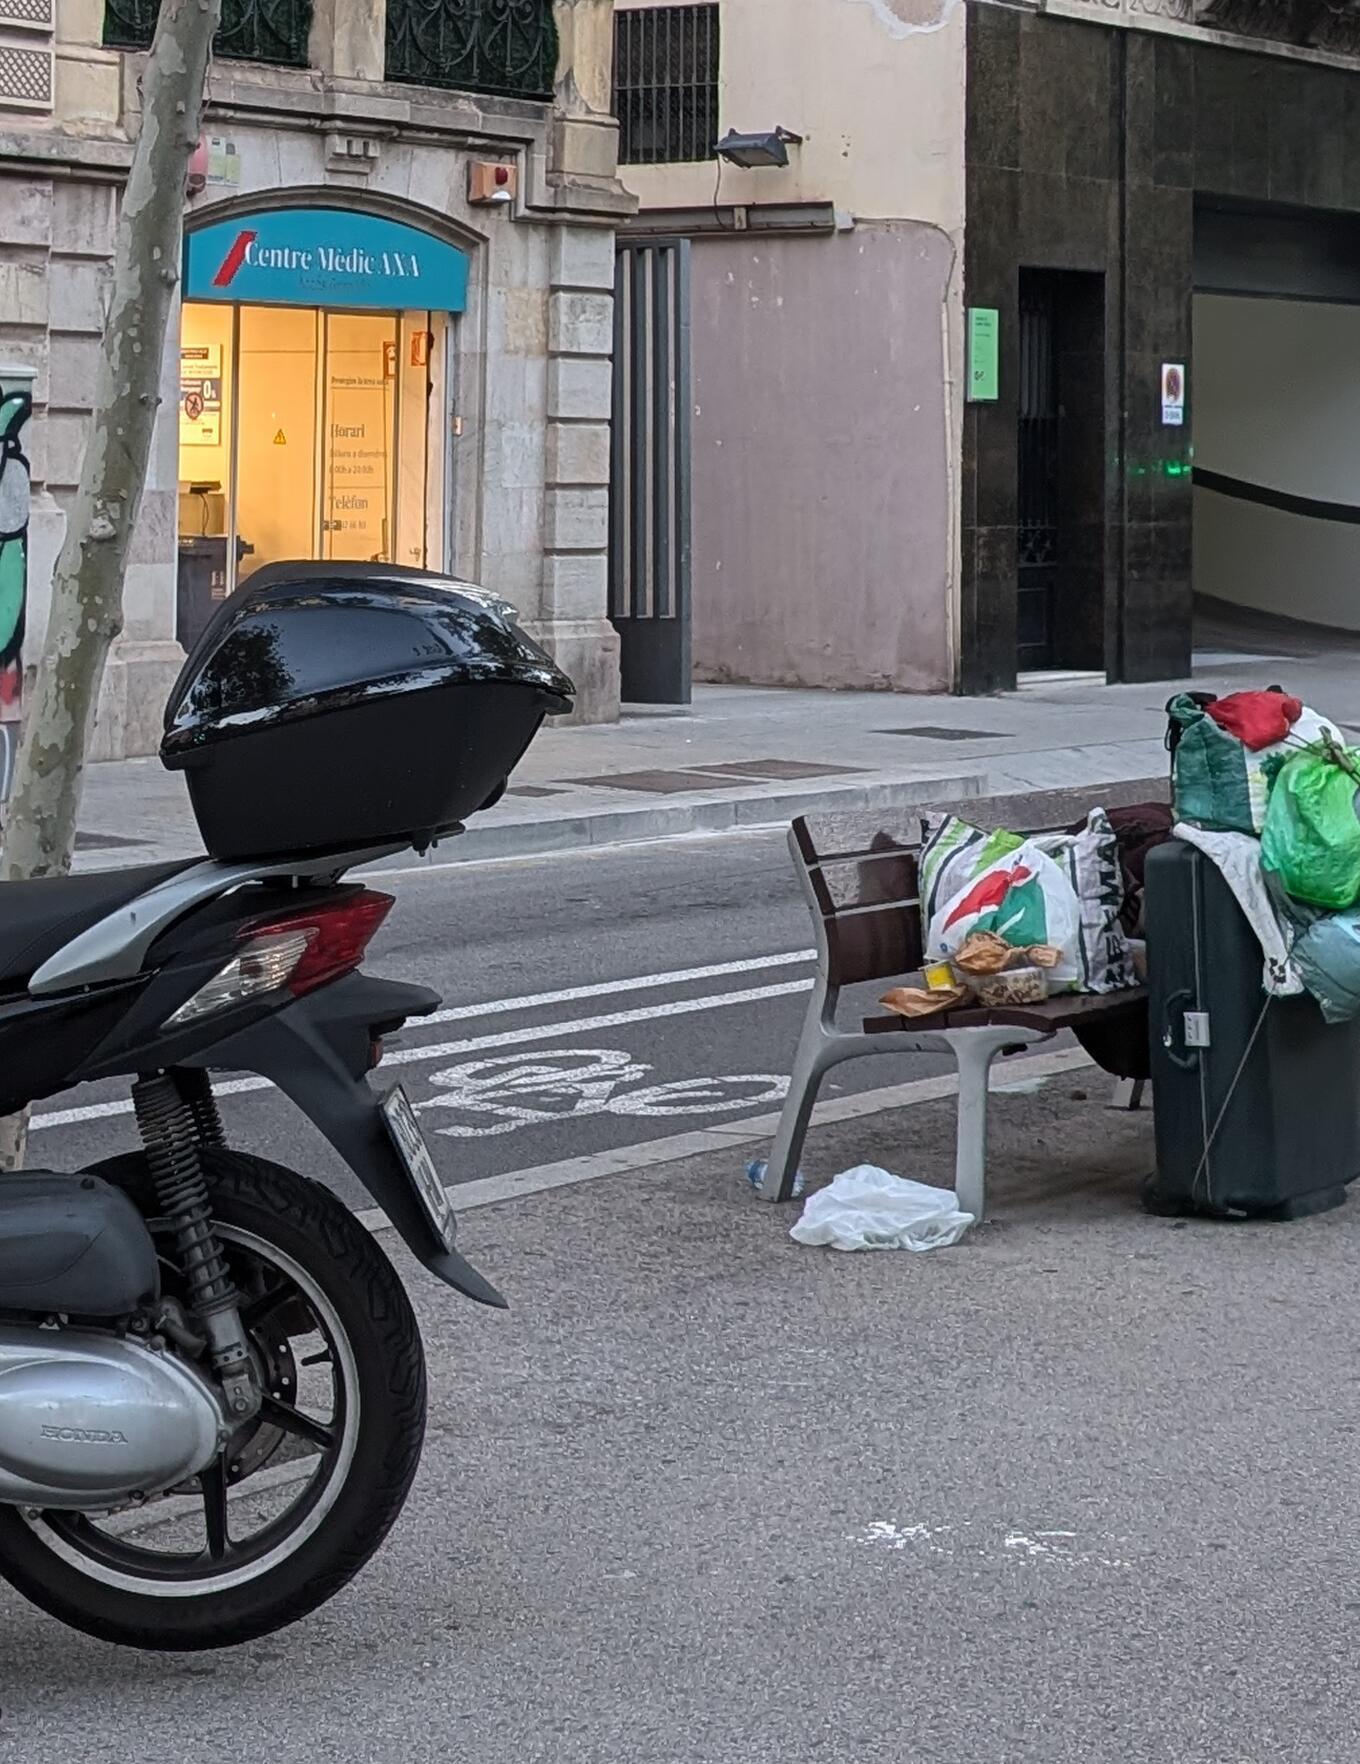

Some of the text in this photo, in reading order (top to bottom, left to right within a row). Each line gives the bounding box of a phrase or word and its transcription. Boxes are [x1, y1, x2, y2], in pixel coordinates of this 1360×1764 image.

[244, 241, 312, 270] Centre
[378, 252, 420, 277] AXA
[40, 1424, 129, 1444] HONDA
